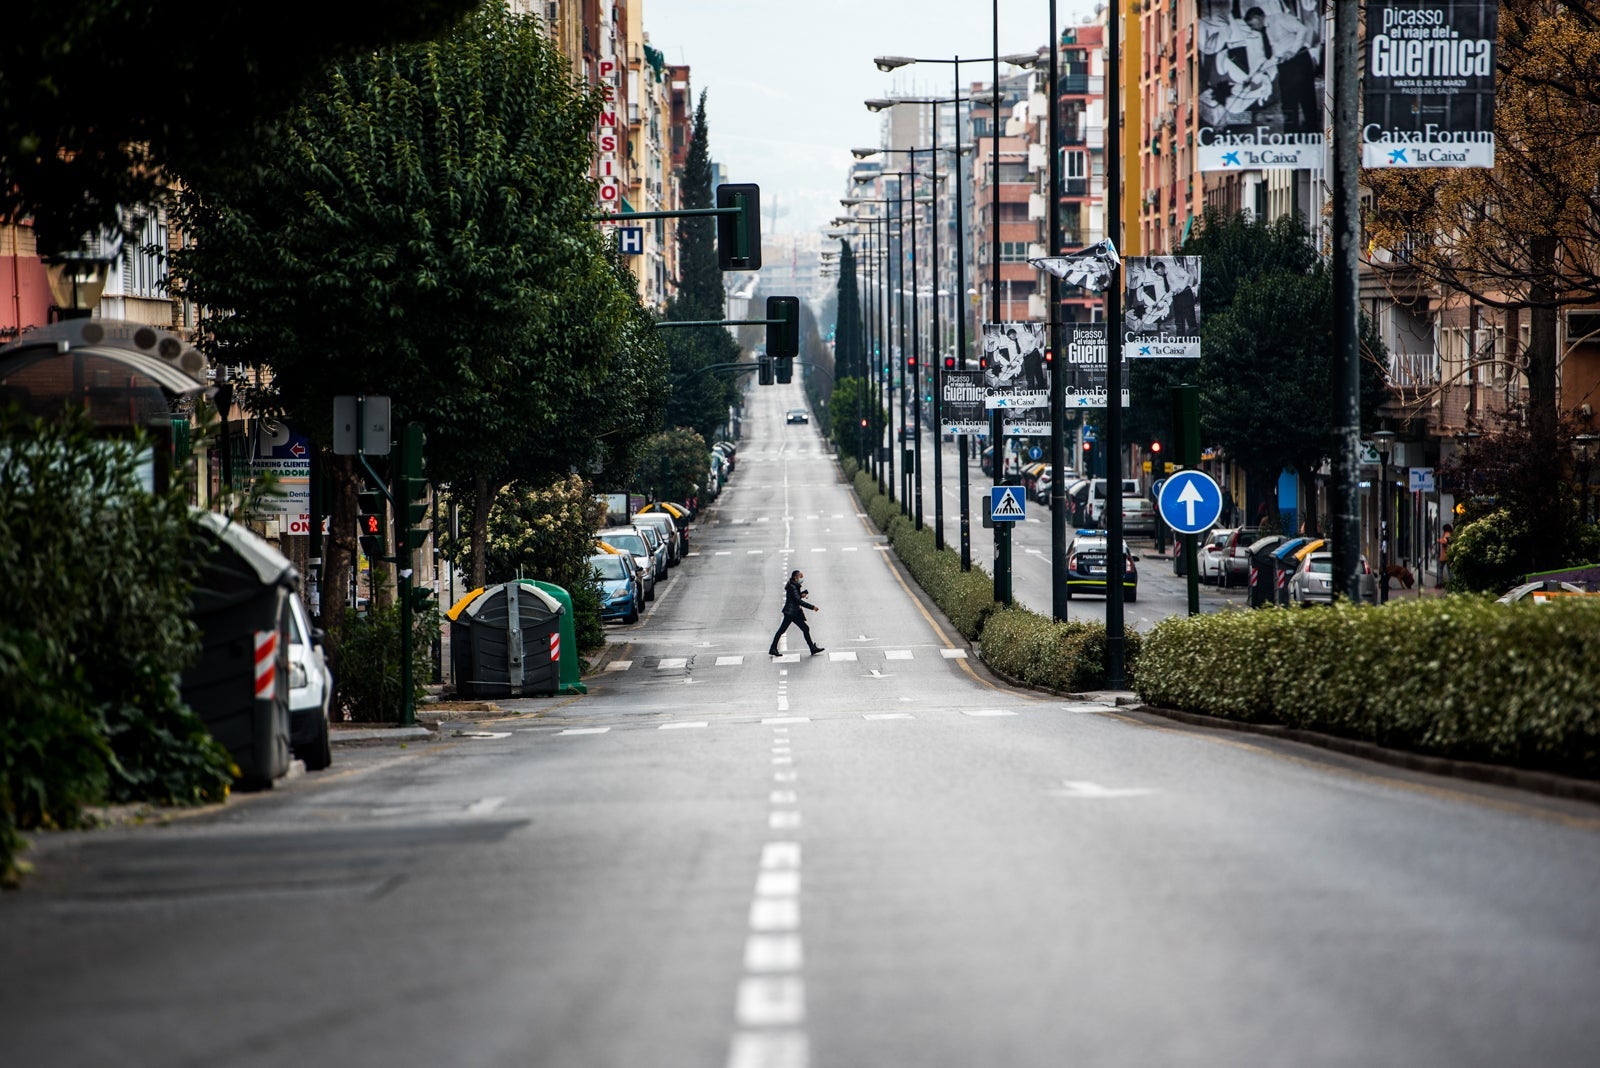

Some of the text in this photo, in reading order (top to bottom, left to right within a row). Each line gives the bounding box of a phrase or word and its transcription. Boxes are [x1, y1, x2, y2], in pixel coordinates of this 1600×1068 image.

[1383, 7, 1443, 34] picasso
[1390, 25, 1450, 40] el viaje del
[1372, 32, 1491, 77] Guernica
[1198, 126, 1324, 147] CaixaForum
[1363, 123, 1495, 144] CaixaForum
[622, 230, 639, 251] H
[1074, 330, 1102, 342] picasso
[1125, 331, 1201, 344] CaixaForum
[1069, 343, 1125, 363] Guerna
[948, 376, 969, 385] picasso
[986, 386, 1048, 397] CaixaForum
[1065, 386, 1129, 396] CaixaFom
[1004, 418, 1051, 426] CaixaForum
[260, 420, 290, 456] P
